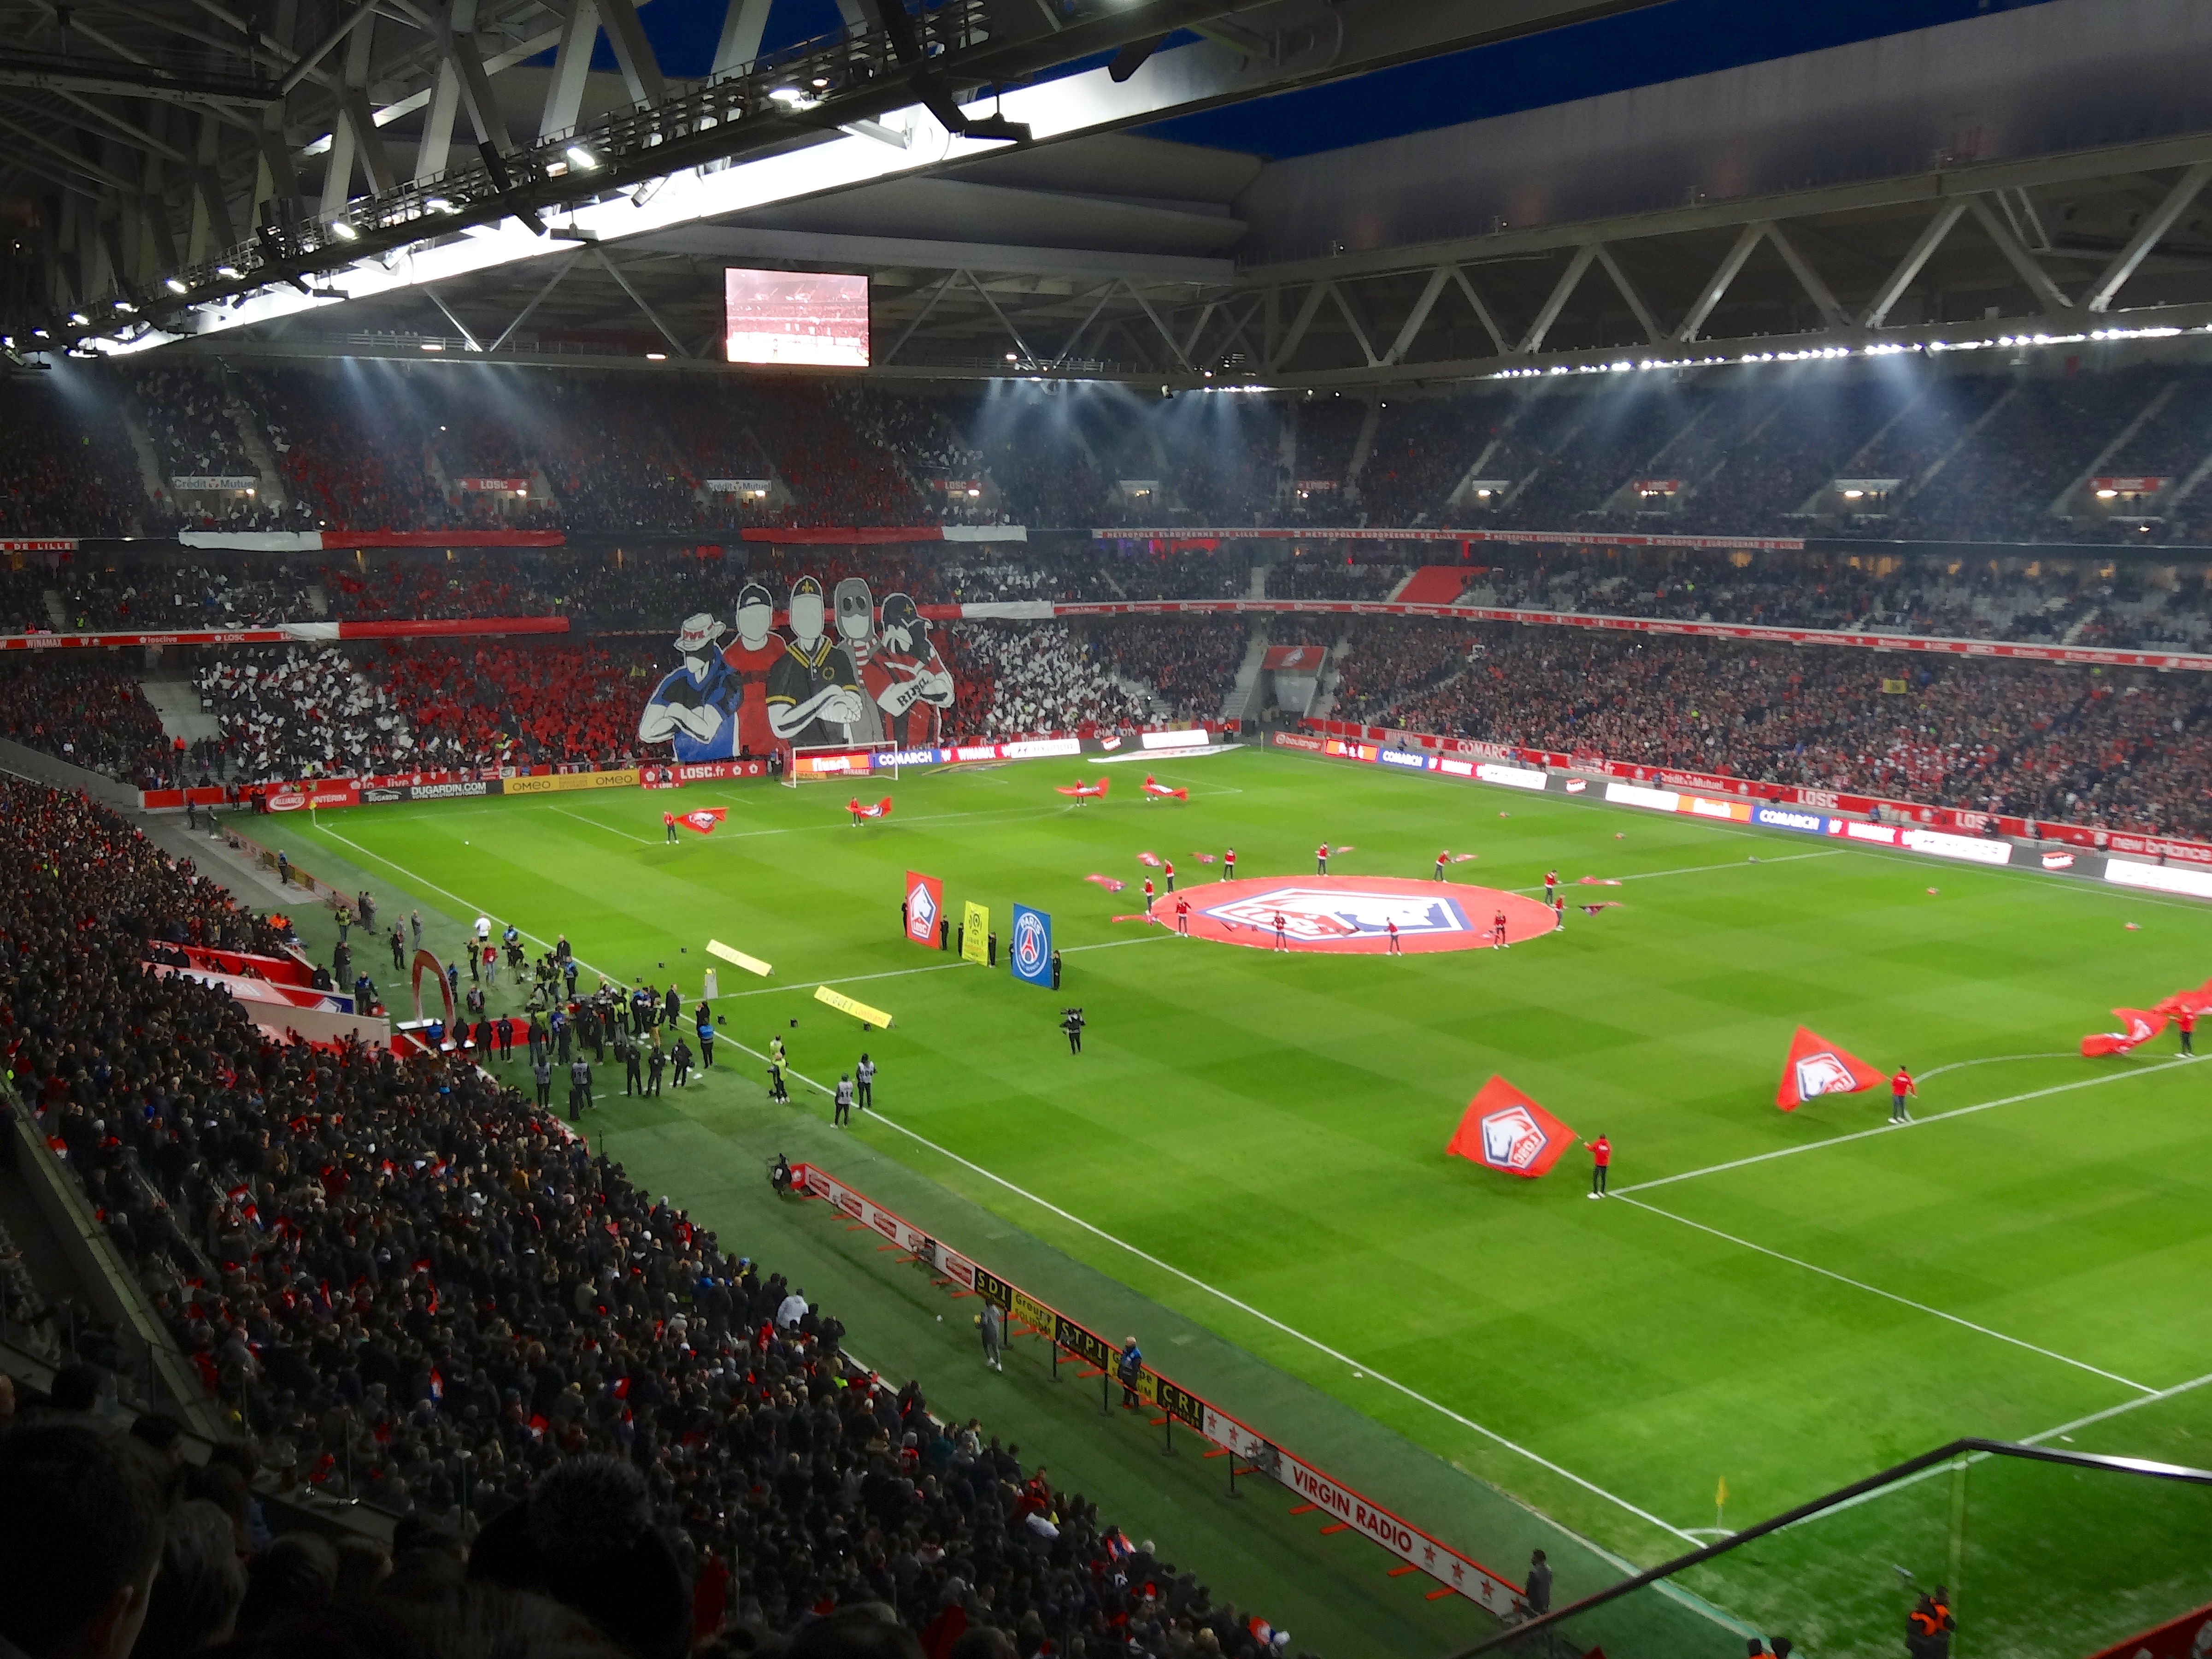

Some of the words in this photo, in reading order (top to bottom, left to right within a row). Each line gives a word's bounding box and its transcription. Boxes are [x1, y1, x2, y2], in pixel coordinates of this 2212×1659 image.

[480, 480, 508, 489] LOSC
[944, 480, 967, 490] LOSC
[26, 638, 62, 648] WINAMAX
[957, 745, 996, 761] WINAMAX
[1457, 739, 1511, 760] COMARC
[812, 756, 851, 772] flunch
[878, 751, 932, 766] COMARCH
[1382, 750, 1423, 767] COMARCH
[680, 766, 725, 780] LOSC.fr
[411, 781, 487, 796] DUGARDIN.COM
[1798, 789, 1839, 809] LOSC
[1759, 809, 1820, 831] COMARCH
[2112, 836, 2144, 852] new
[2145, 838, 2212, 861] balance
[913, 920, 928, 934] LOSC
[1020, 916, 1041, 935] PARIS
[977, 1271, 1007, 1301] SDI
[1062, 1322, 1103, 1359] STPI
[1163, 1385, 1200, 1420] CRI
[1292, 1465, 1350, 1517] VIRGIN
[1356, 1504, 1413, 1553] RADIO
